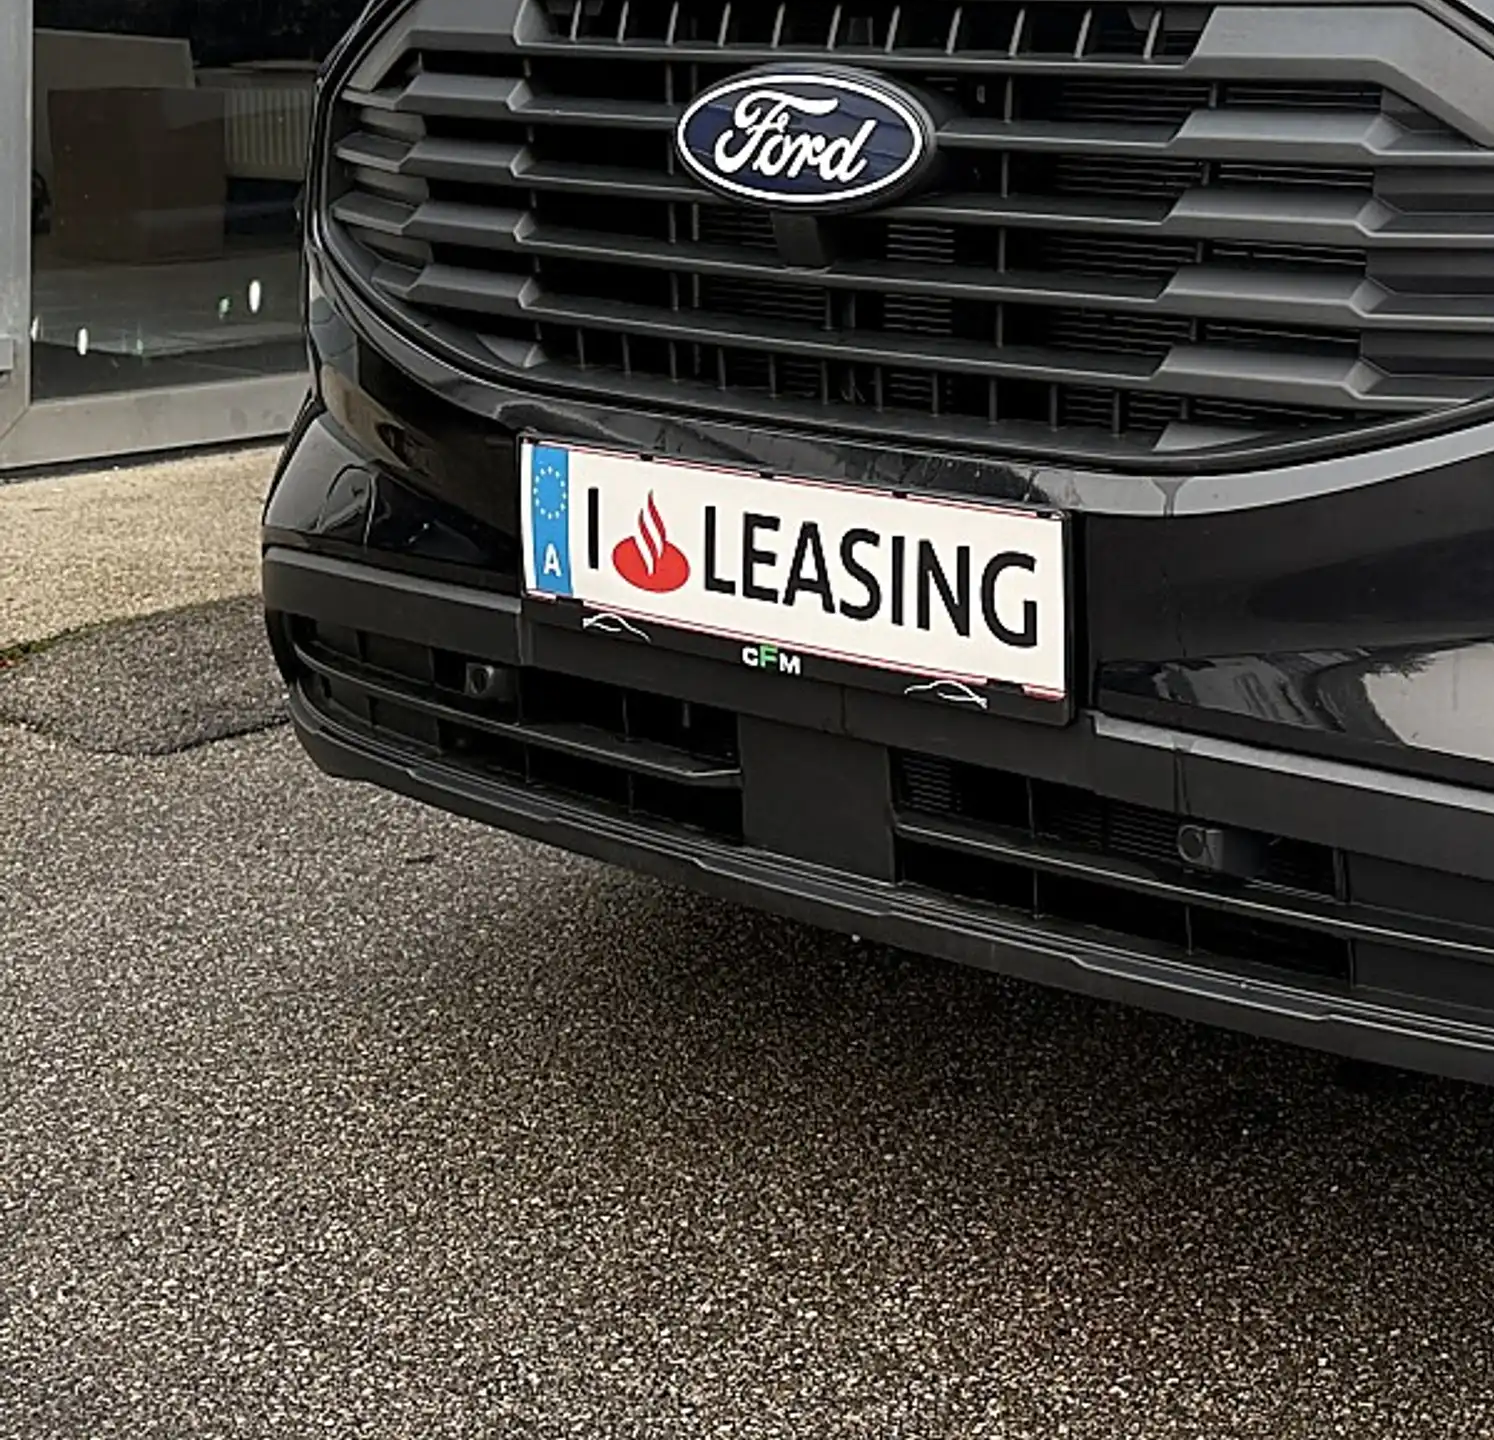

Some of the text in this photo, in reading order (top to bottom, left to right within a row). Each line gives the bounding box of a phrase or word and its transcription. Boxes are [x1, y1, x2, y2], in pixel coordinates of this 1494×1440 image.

[714, 90, 878, 183] Ford
[542, 542, 563, 578] A
[587, 486, 1039, 649] I LEASING
[742, 645, 801, 675] CFM
